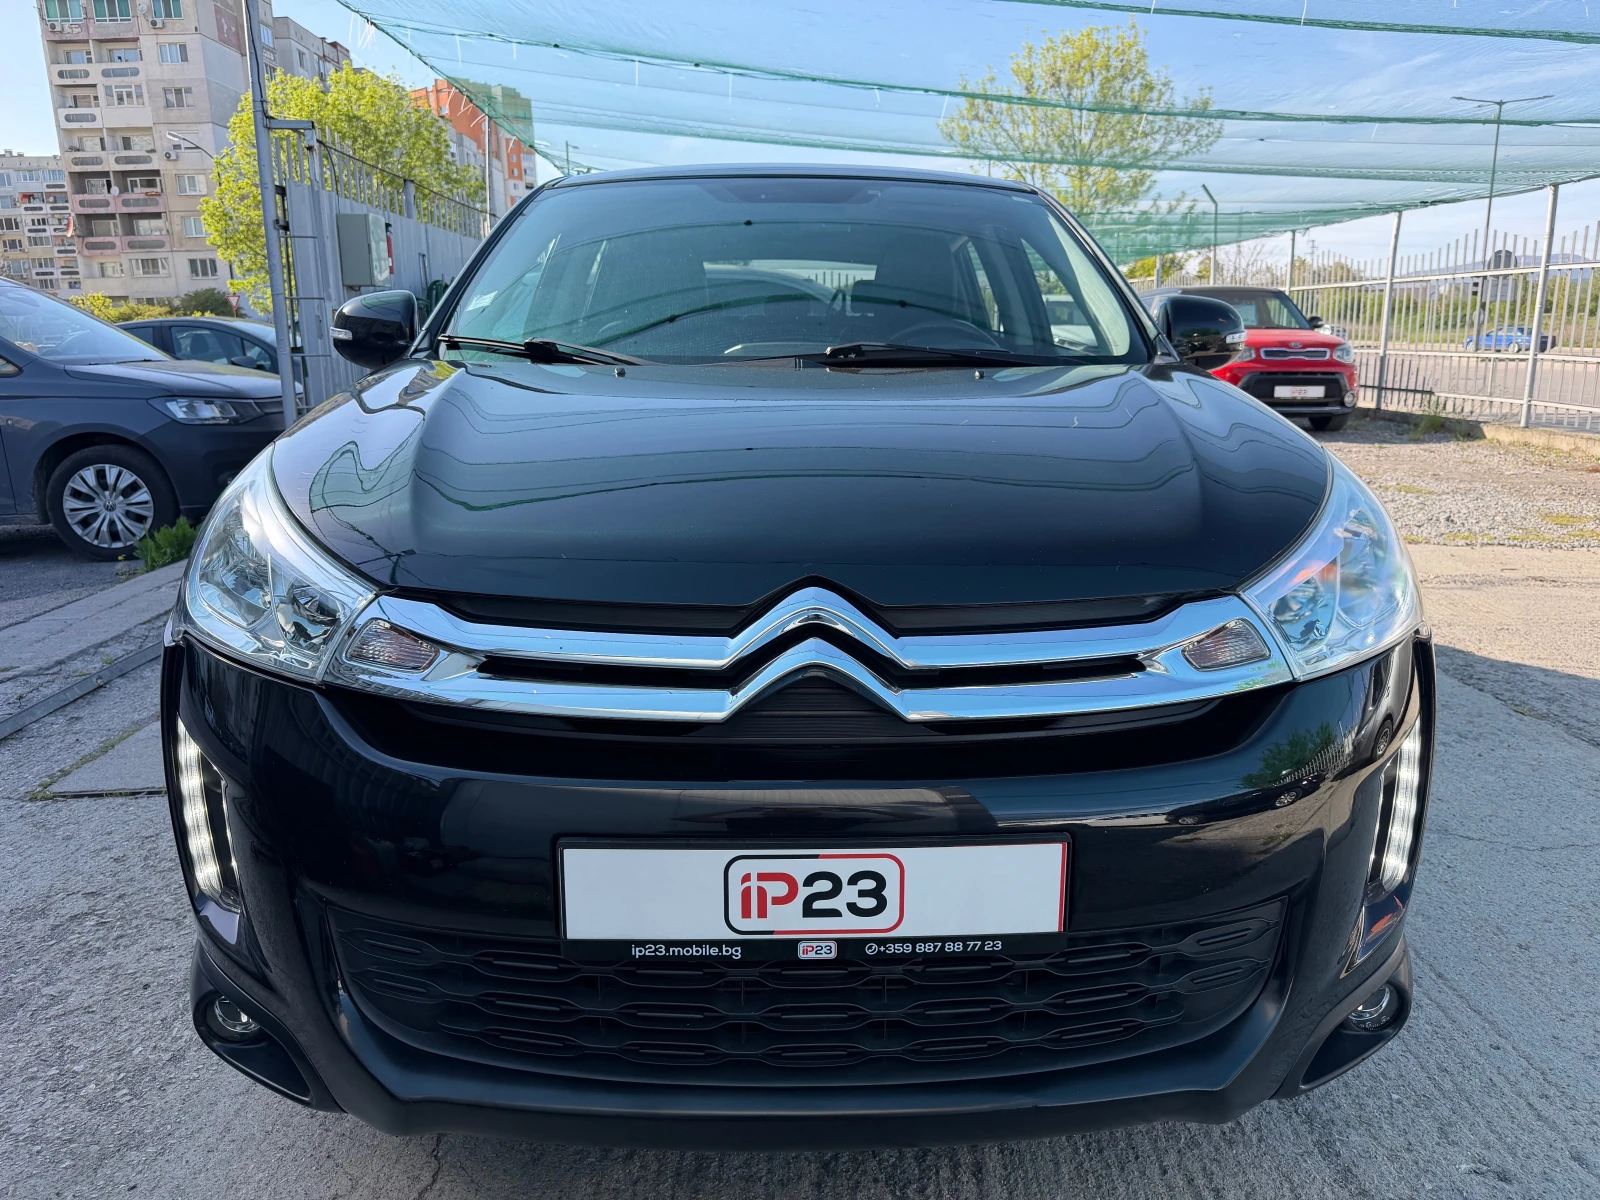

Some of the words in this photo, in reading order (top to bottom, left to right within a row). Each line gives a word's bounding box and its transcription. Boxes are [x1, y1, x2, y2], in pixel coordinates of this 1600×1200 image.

[631, 944, 742, 959] ip23.mobile.bg
[879, 943, 912, 954] +359
[915, 942, 942, 953] 887
[944, 942, 963, 952] 88
[966, 941, 982, 951] 77
[984, 940, 1002, 950] 23
